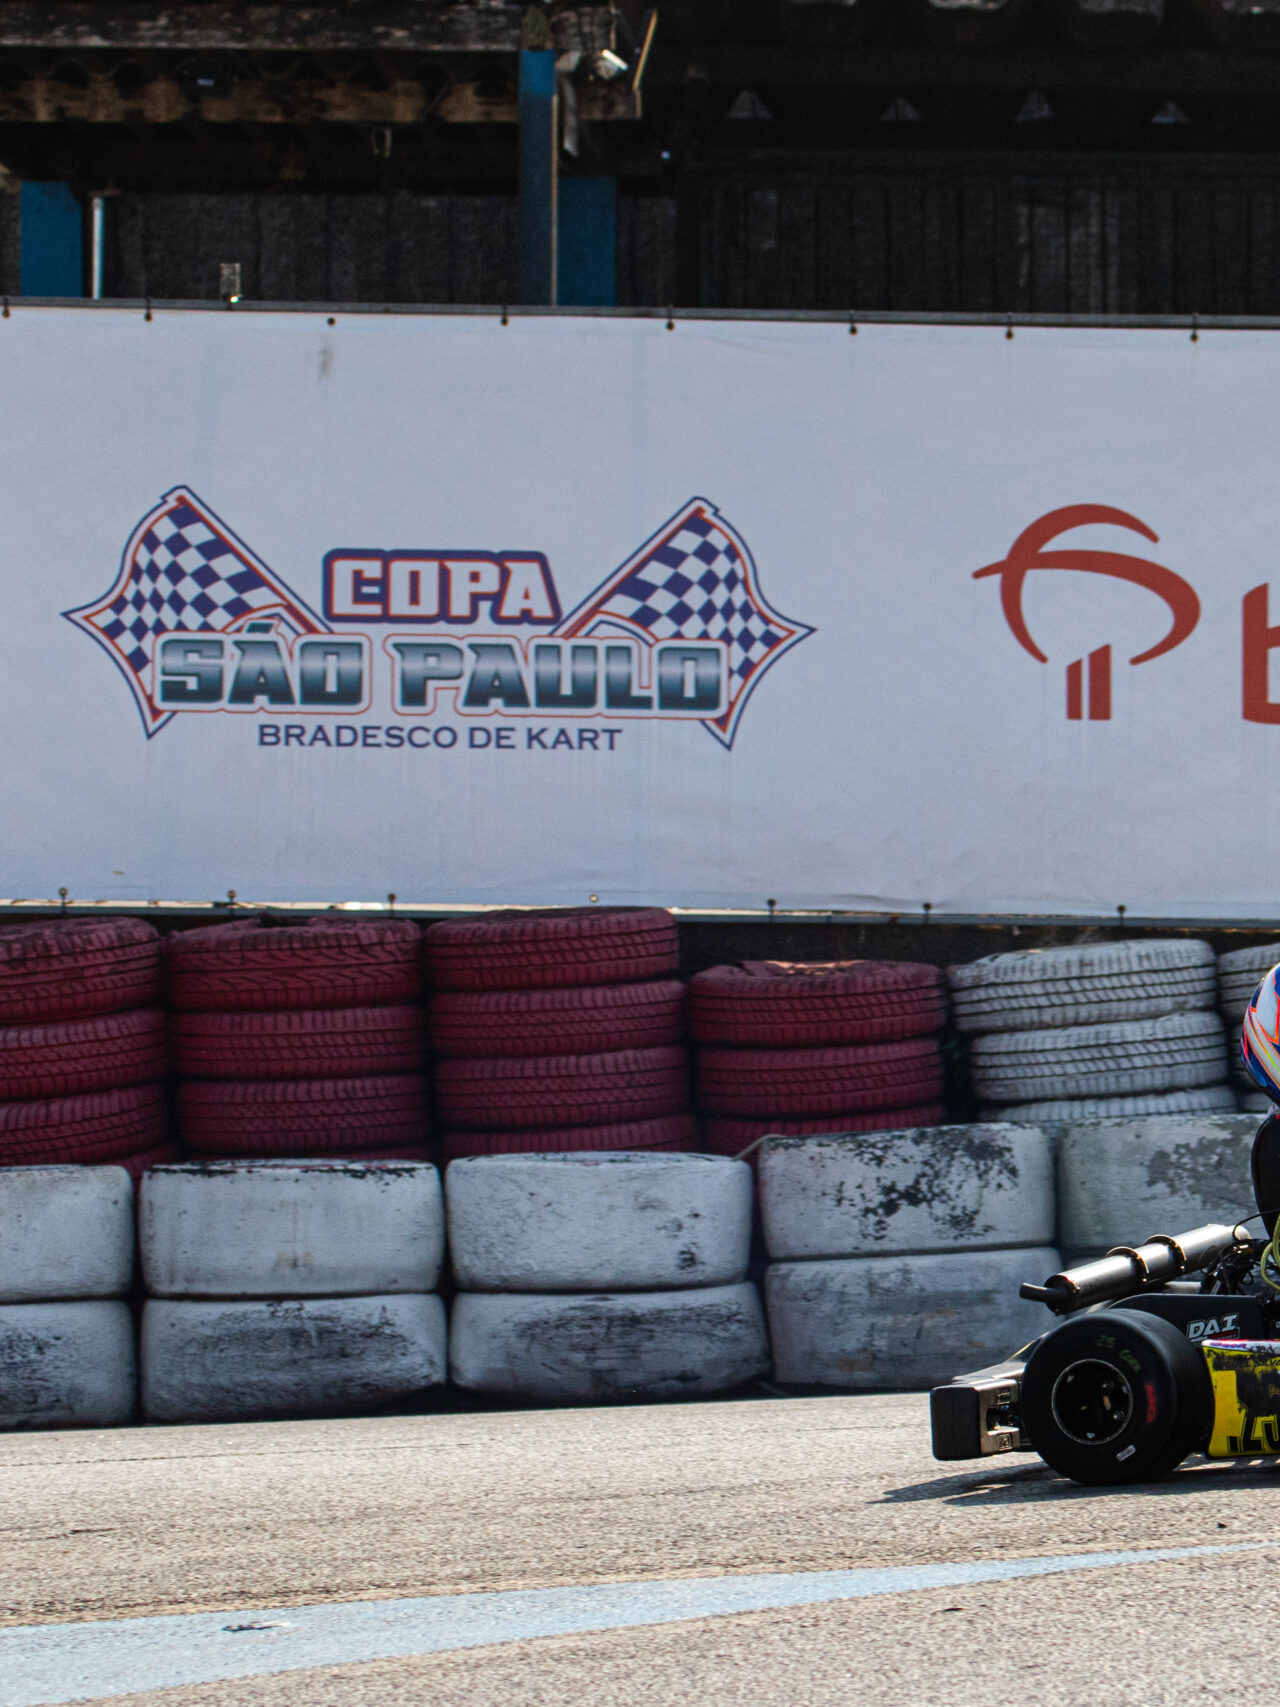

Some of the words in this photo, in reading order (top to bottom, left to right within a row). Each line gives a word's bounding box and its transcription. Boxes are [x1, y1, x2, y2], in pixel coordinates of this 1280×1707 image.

[326, 552, 560, 623] COPA
[158, 618, 365, 708] SÃO
[392, 635, 724, 712] PAULO
[257, 723, 458, 750] BRADESCO
[466, 725, 516, 750] DE
[525, 727, 623, 752] KART
[1188, 1314, 1238, 1339] DAI
